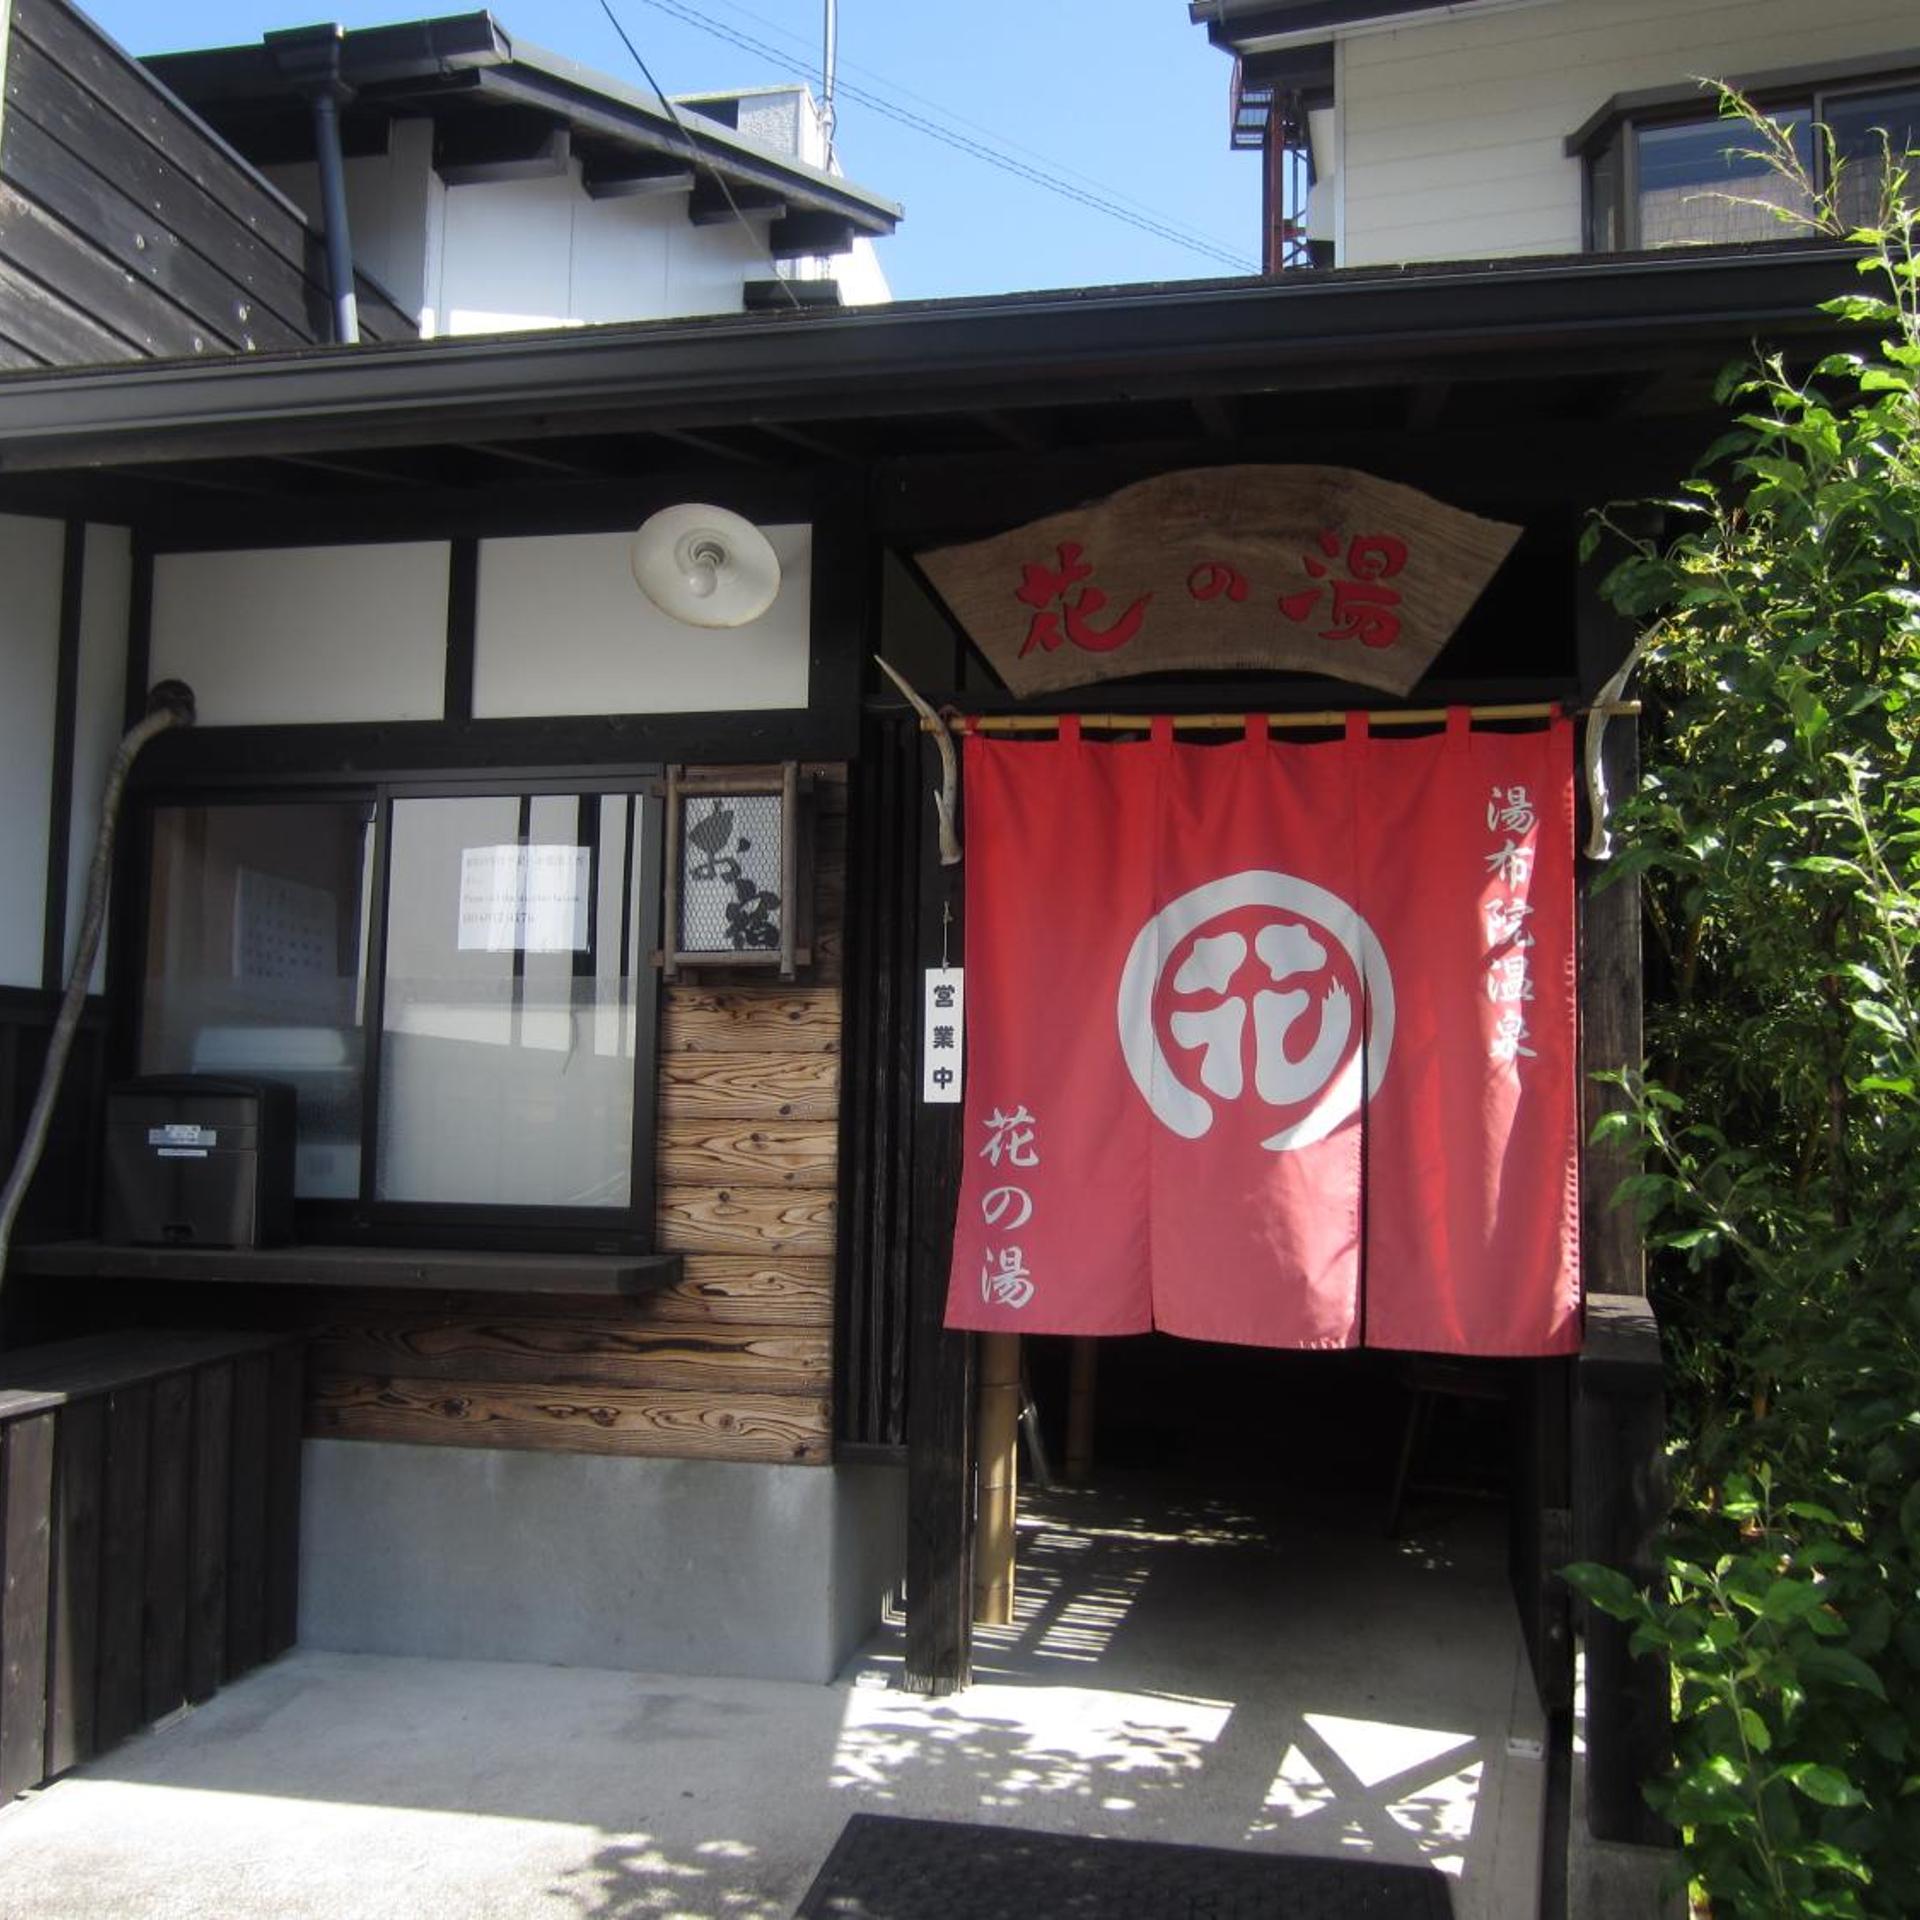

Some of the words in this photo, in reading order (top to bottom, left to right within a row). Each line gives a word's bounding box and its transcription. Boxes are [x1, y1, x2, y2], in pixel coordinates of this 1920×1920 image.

[1016, 531, 1408, 658] 花の湯
[1485, 786, 1537, 1058] 湯布院温泉
[933, 984, 955, 1089] 営業中
[1170, 924, 1351, 1106] 花
[979, 1105, 1040, 1309] 花の湯
